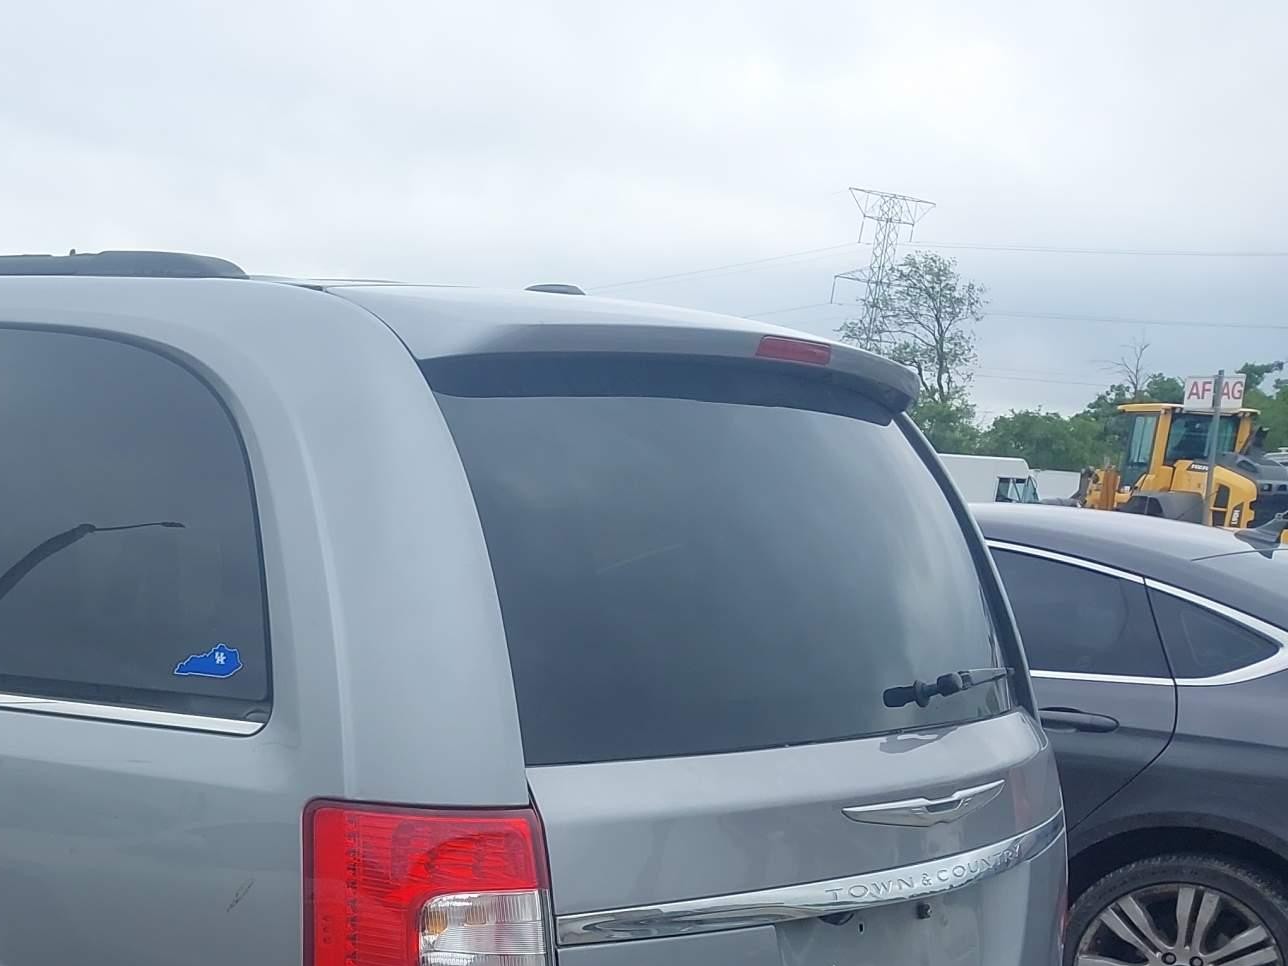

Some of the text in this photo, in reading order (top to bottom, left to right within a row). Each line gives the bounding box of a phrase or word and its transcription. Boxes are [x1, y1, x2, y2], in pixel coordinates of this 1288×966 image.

[825, 843, 1024, 901] TOWN & COUNTRY
